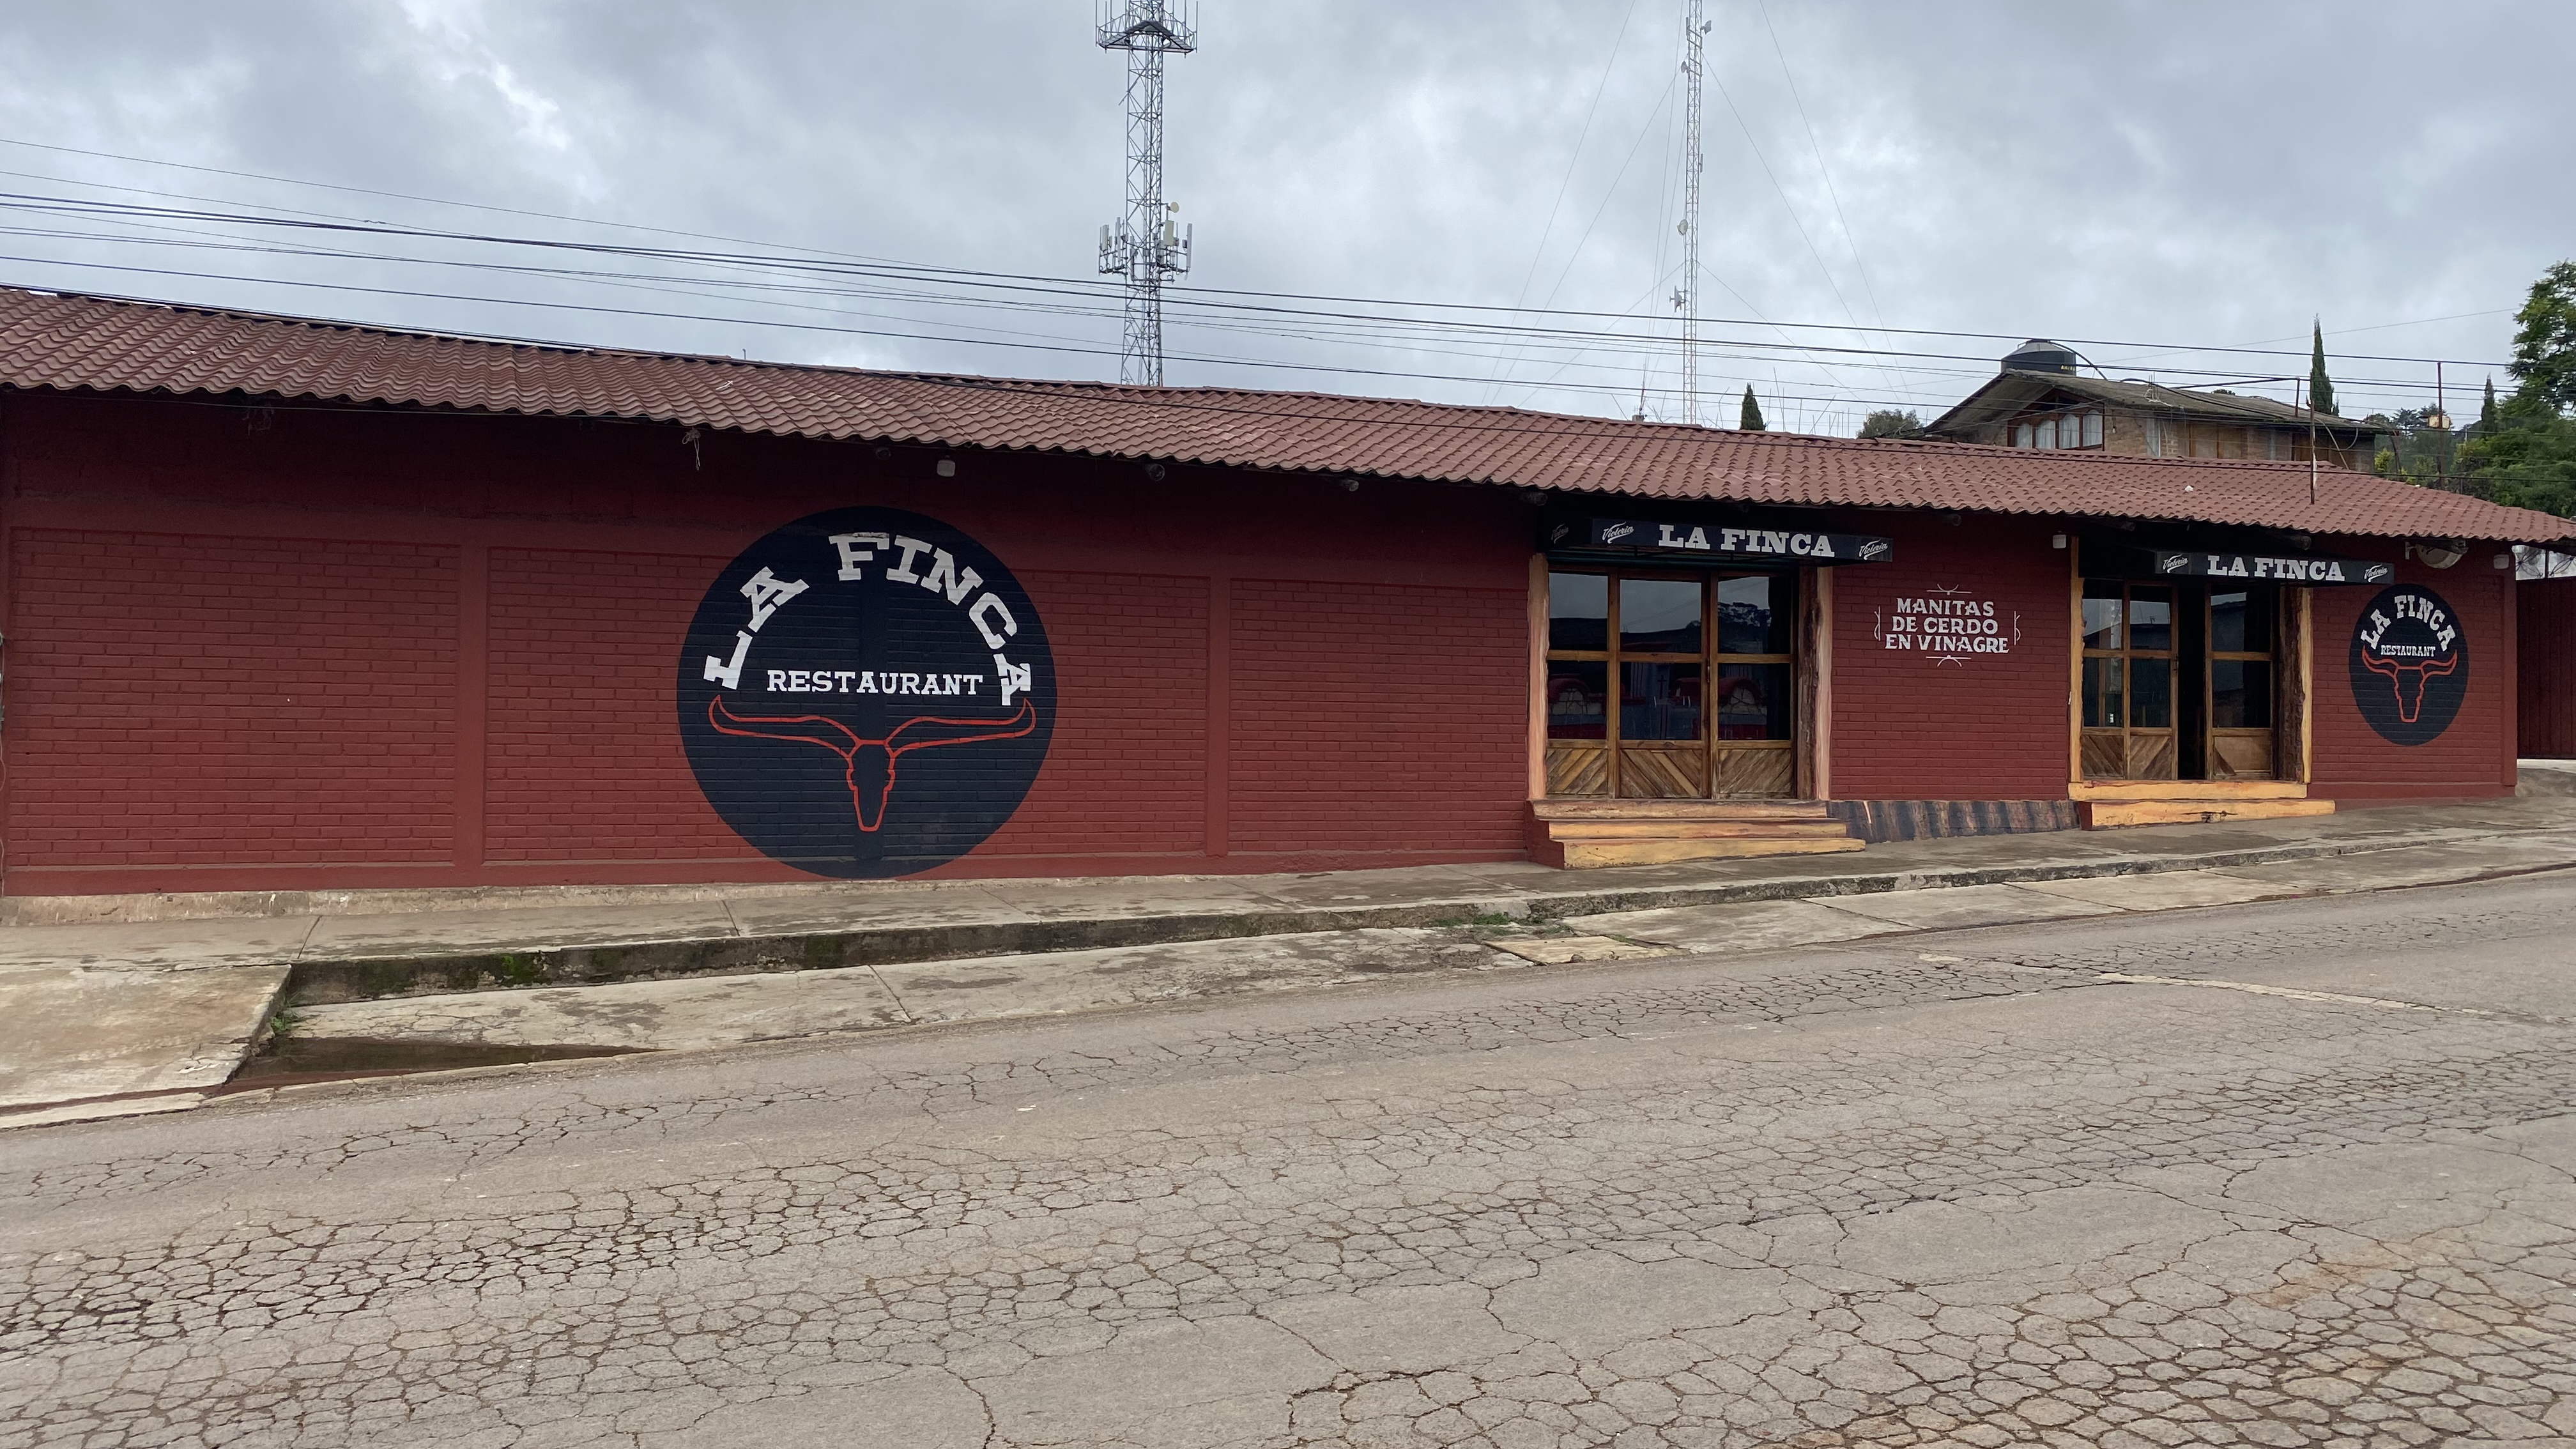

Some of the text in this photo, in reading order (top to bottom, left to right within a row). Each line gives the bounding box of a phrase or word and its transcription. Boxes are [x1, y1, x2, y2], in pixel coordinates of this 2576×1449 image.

[1602, 521, 1634, 544] Victoria
[1659, 525, 1835, 557] LA FINCA
[1859, 539, 1888, 560] Victoria
[2163, 554, 2188, 573] Victoria
[2207, 555, 2345, 581] LA FINCA
[2364, 564, 2388, 582] Victoria
[1896, 597, 1994, 617] MANITAS
[703, 532, 1031, 706] LA FINCA
[1892, 617, 1998, 634] DE CERDO
[2361, 595, 2456, 652] LA FINCA
[1885, 634, 2009, 653] EN VINAGRE
[2380, 645, 2435, 657] RESTAURANT
[767, 670, 983, 695] RESTAURANT
